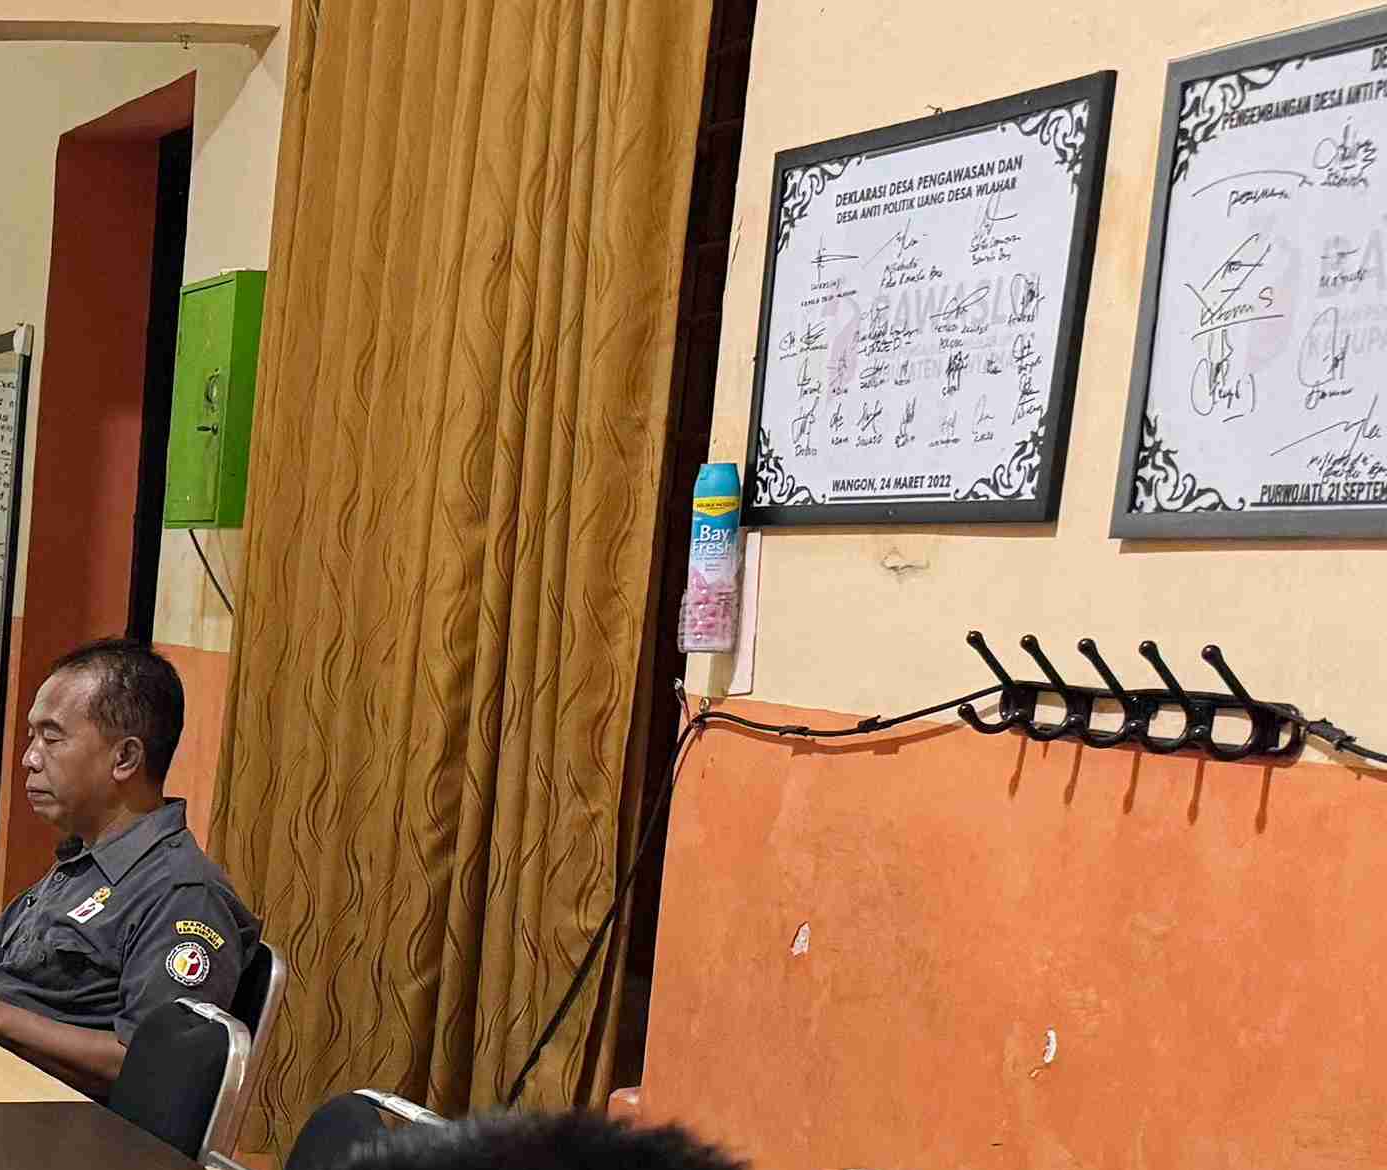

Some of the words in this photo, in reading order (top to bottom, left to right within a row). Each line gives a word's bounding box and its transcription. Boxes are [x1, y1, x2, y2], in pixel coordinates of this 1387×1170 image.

[1221, 95, 1311, 131] PENGEMBANGAN
[1313, 88, 1343, 112] DESA
[1346, 81, 1374, 105] ANTI
[835, 184, 888, 208] DEKLARASI
[889, 178, 915, 197] DESA
[917, 160, 996, 191] PENGAWASAN
[998, 154, 1024, 175] DAN
[836, 208, 859, 225] DESA
[859, 204, 881, 220] ANTI
[883, 196, 916, 216] POLITIK
[917, 191, 945, 208] UANG
[947, 185, 973, 203] DESA
[831, 477, 877, 493] WANGON,
[880, 476, 893, 491] 24
[894, 475, 925, 490] MARET
[926, 474, 952, 489] 2022
[691, 538, 733, 554] Fresh
[699, 524, 731, 542] Bay
